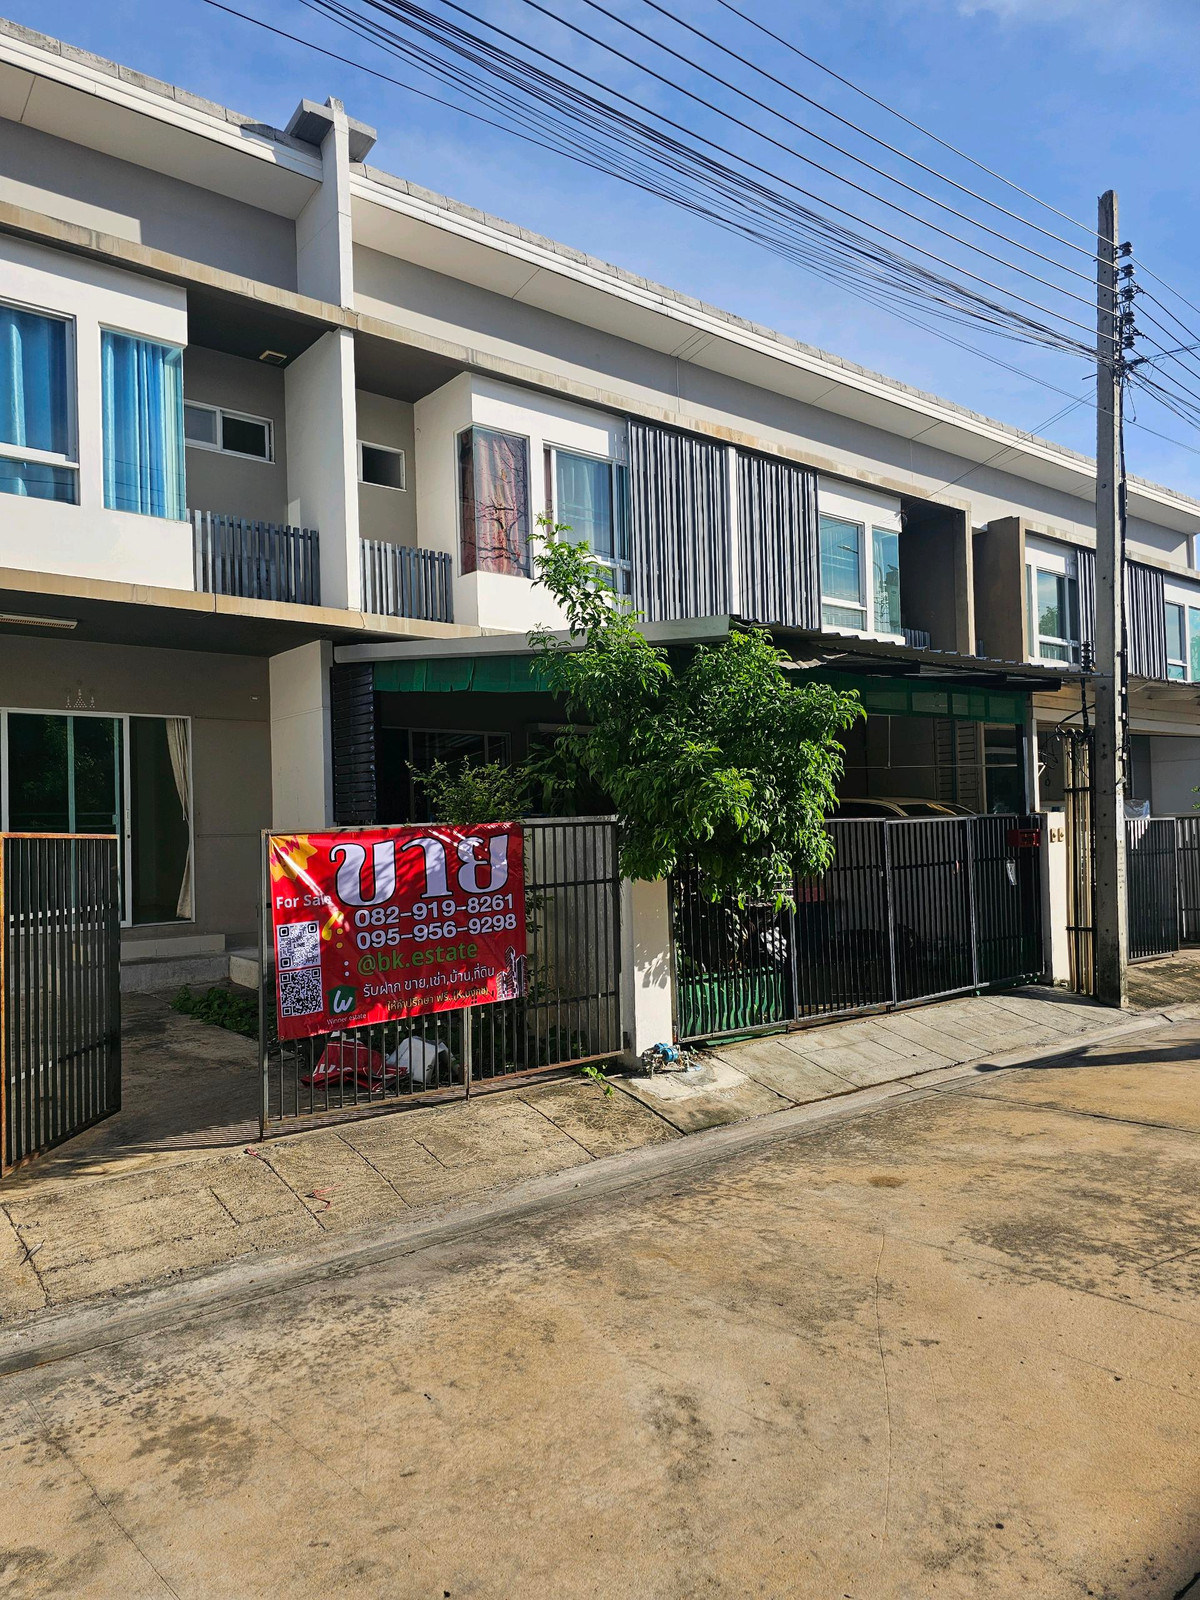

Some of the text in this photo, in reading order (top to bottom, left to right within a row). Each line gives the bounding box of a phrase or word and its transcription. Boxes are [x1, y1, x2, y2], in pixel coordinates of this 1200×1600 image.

[329, 834, 509, 906] ขาย
[276, 893, 332, 910] For Sale
[354, 893, 514, 928] 082-919-8261
[356, 913, 517, 950] 095-956-9298
[357, 943, 478, 976] @bk.estate
[363, 982, 401, 998] รับฝาก
[349, 1013, 366, 1021] estate
